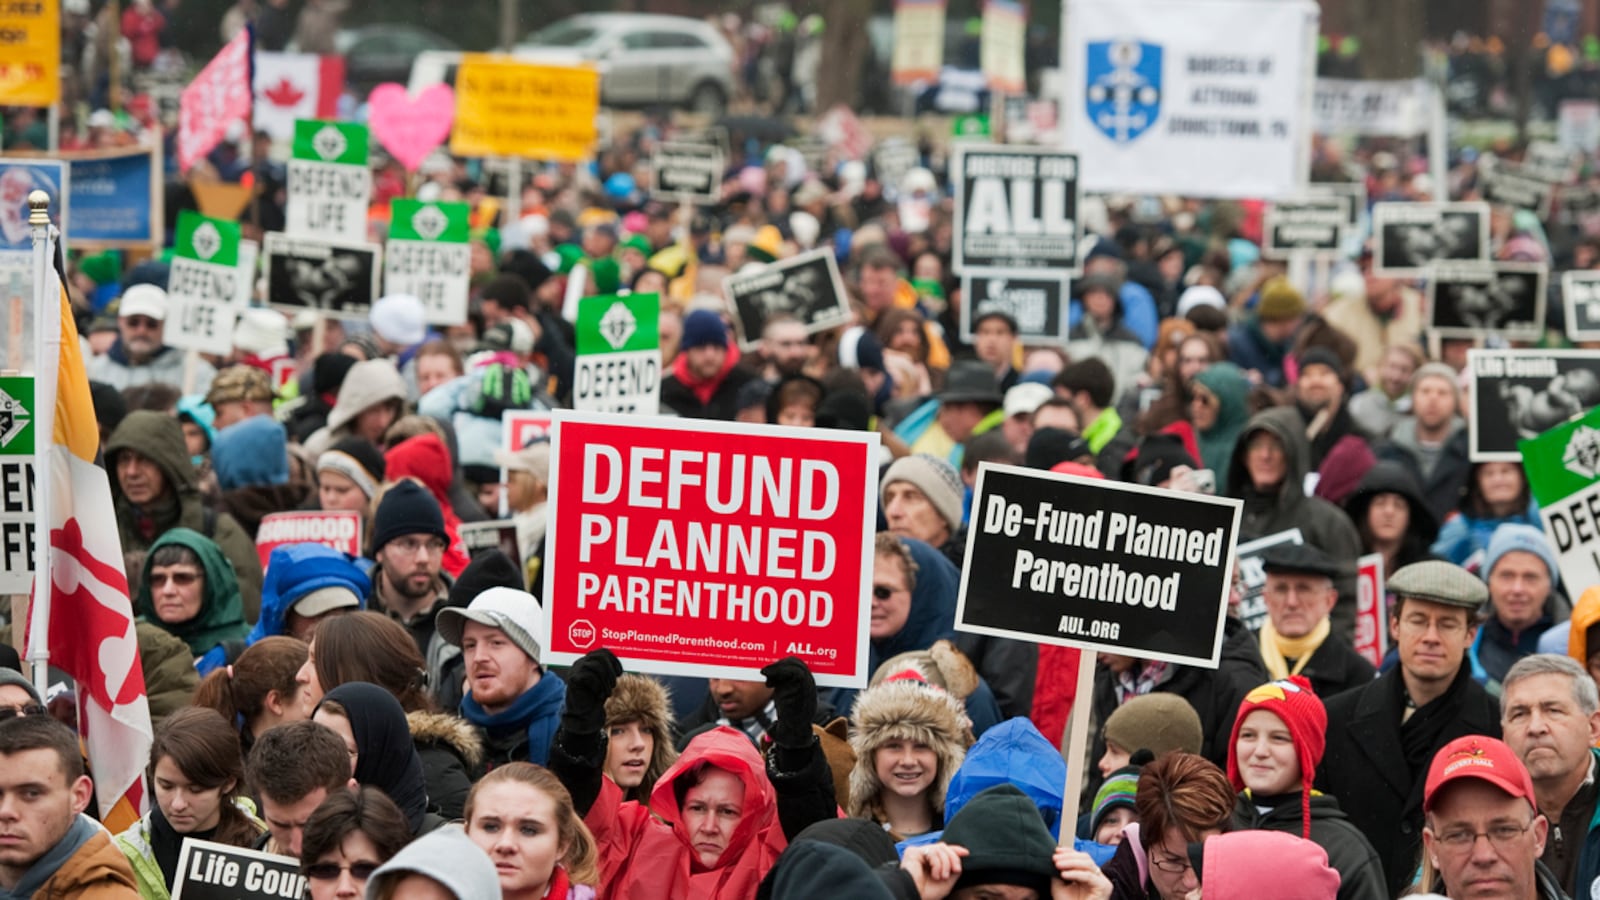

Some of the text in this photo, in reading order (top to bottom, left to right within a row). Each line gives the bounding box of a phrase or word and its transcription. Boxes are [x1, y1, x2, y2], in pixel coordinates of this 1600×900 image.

[289, 166, 365, 199] DEFEND
[306, 201, 347, 233] LIFE
[965, 177, 1075, 235] ALL
[389, 242, 465, 277] DEFEND
[172, 263, 236, 302] DEFEND
[180, 302, 218, 338] LIFE
[579, 357, 657, 399] DEFEND
[582, 443, 840, 520] DEFUND
[579, 513, 837, 581] PLANNED
[984, 494, 1224, 567] De-Fund Planned
[1011, 549, 1181, 612] Parenthood
[577, 572, 834, 628] PARENTHOOD
[572, 627, 593, 639] STOP
[602, 627, 766, 652] StopPlannedParenthood.com
[786, 641, 838, 659] ALL.org
[1058, 615, 1121, 640] AUL.ORG
[189, 850, 240, 888] Life
